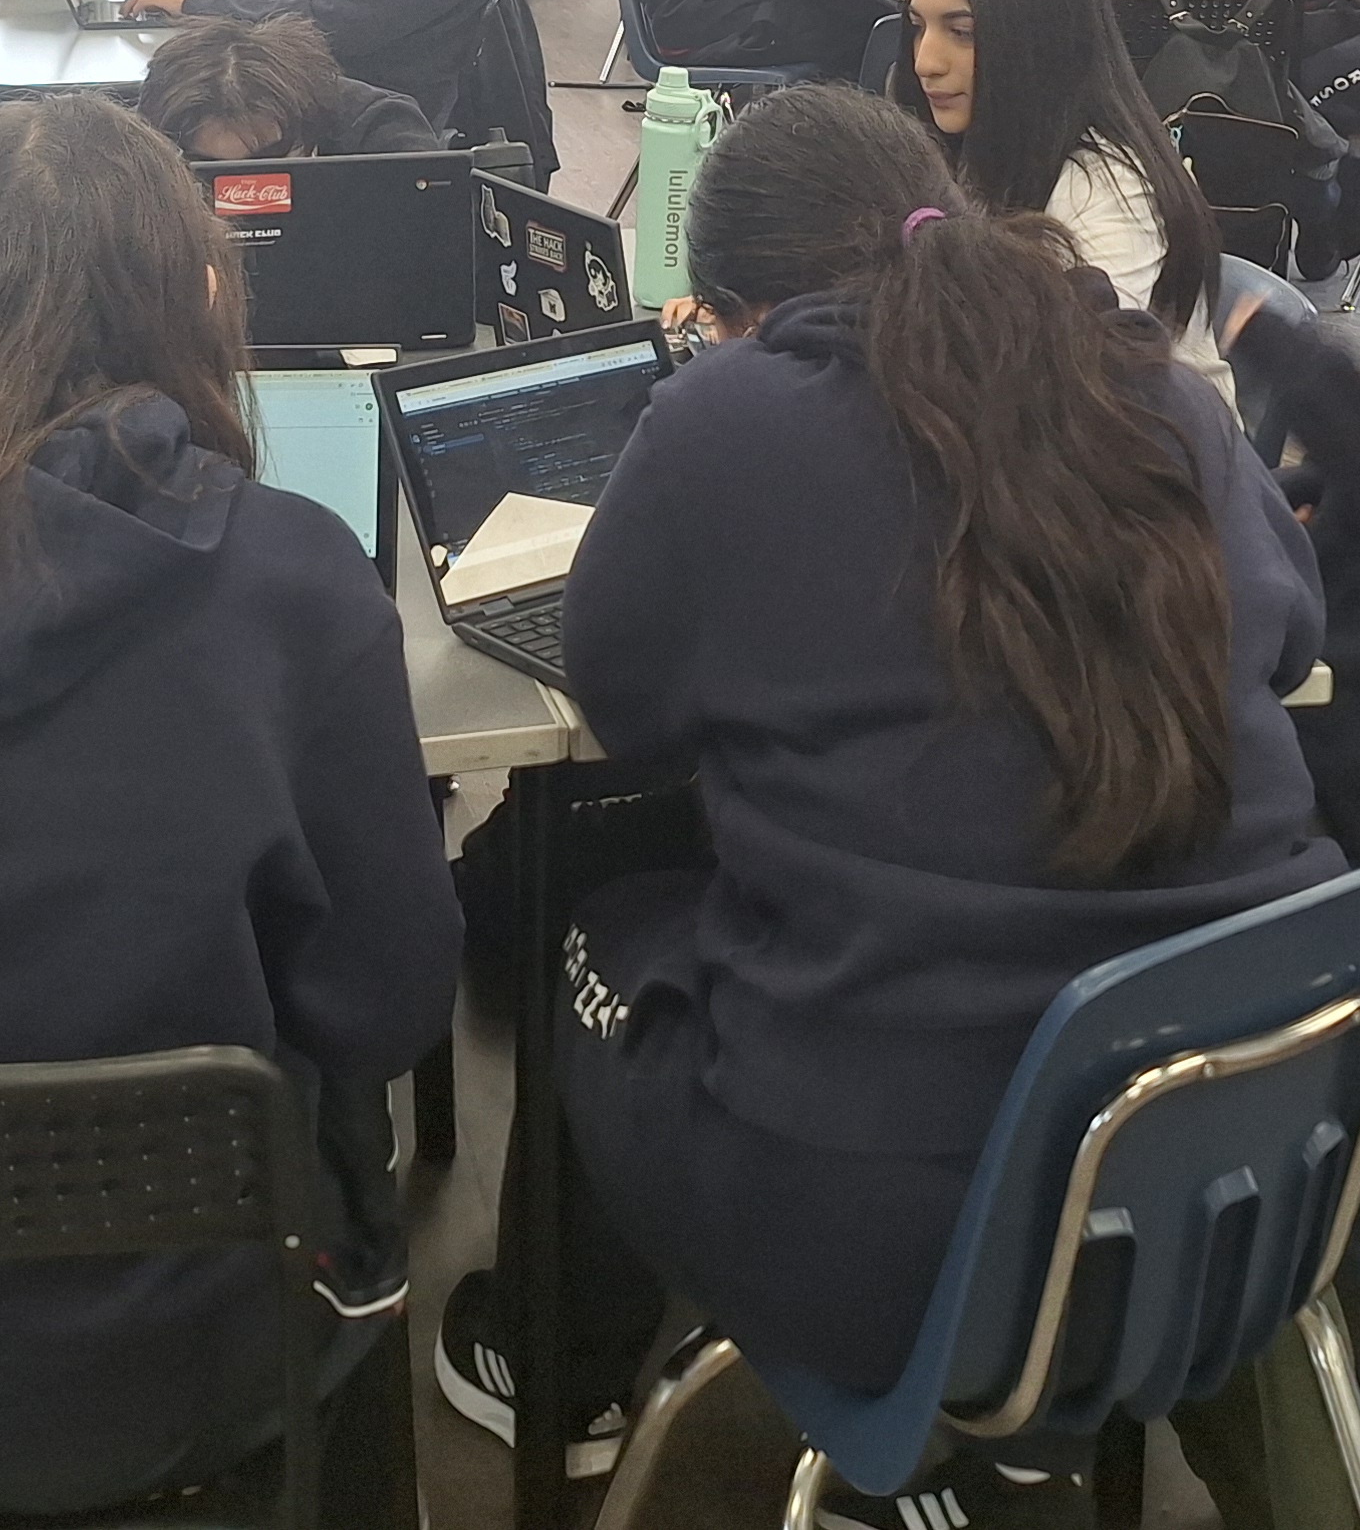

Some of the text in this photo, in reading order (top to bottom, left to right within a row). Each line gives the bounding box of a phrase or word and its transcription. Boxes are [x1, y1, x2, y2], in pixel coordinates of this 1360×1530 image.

[527, 228, 563, 252] THE HACK
[664, 170, 689, 268] lululemon
